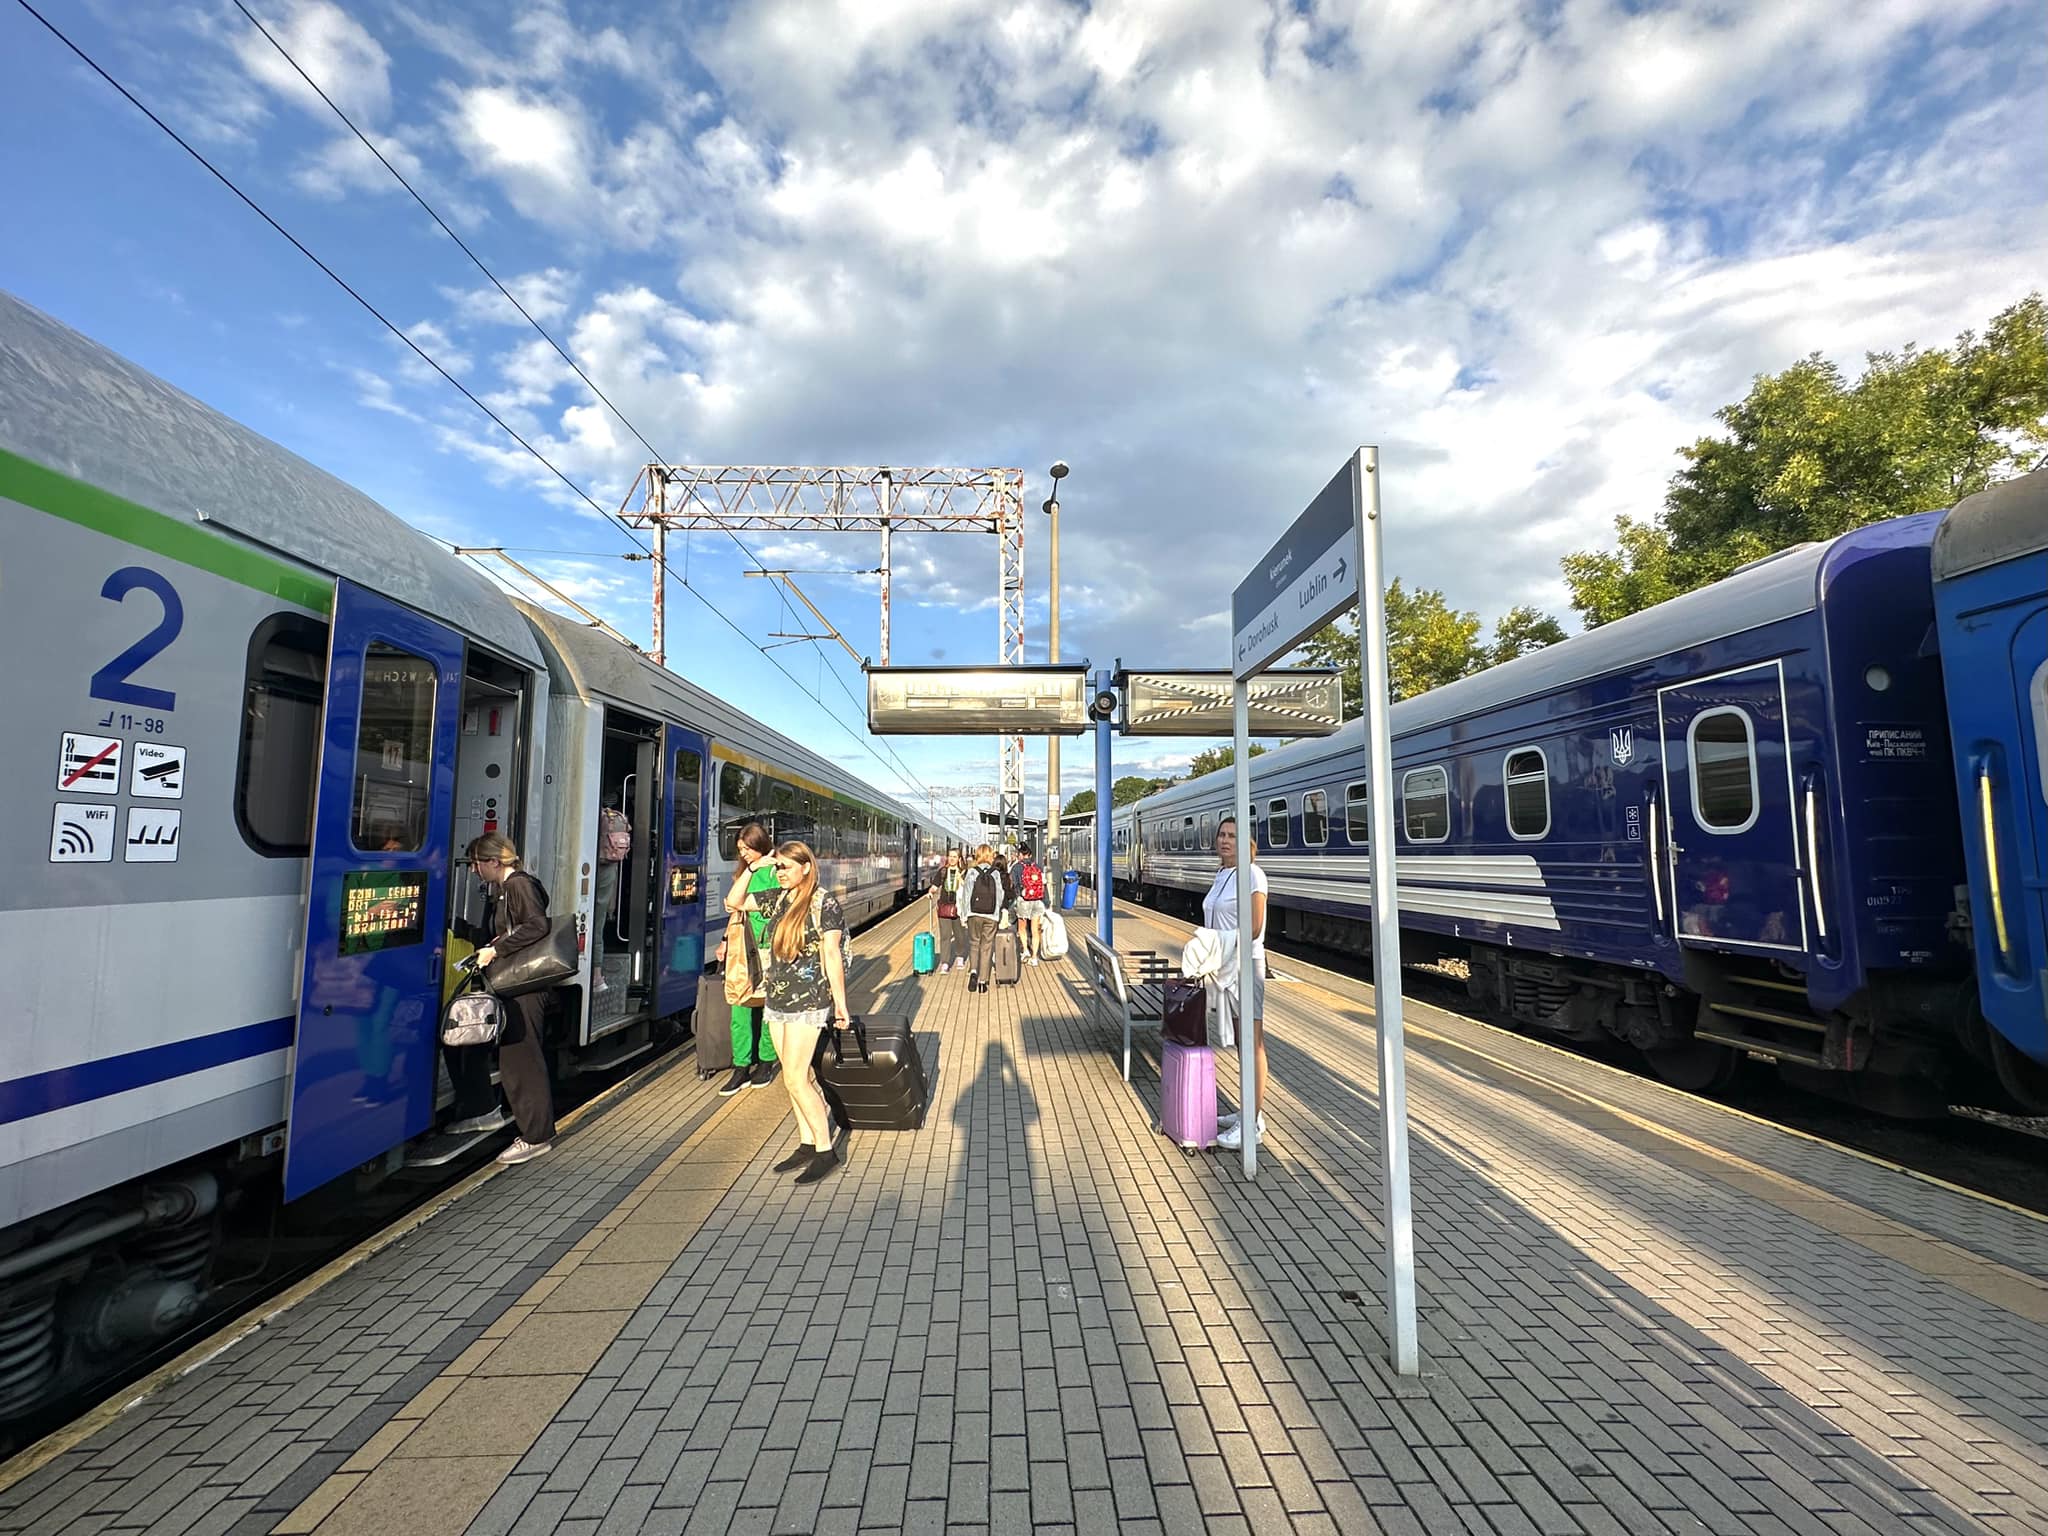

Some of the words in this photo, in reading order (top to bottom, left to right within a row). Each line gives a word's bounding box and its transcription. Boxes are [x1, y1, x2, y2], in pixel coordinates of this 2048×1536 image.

[1299, 574, 1328, 609] Lublin
[90, 566, 184, 712] 2
[120, 714, 164, 734] 11-98
[139, 748, 165, 758] Video
[86, 810, 109, 820] WiFi
